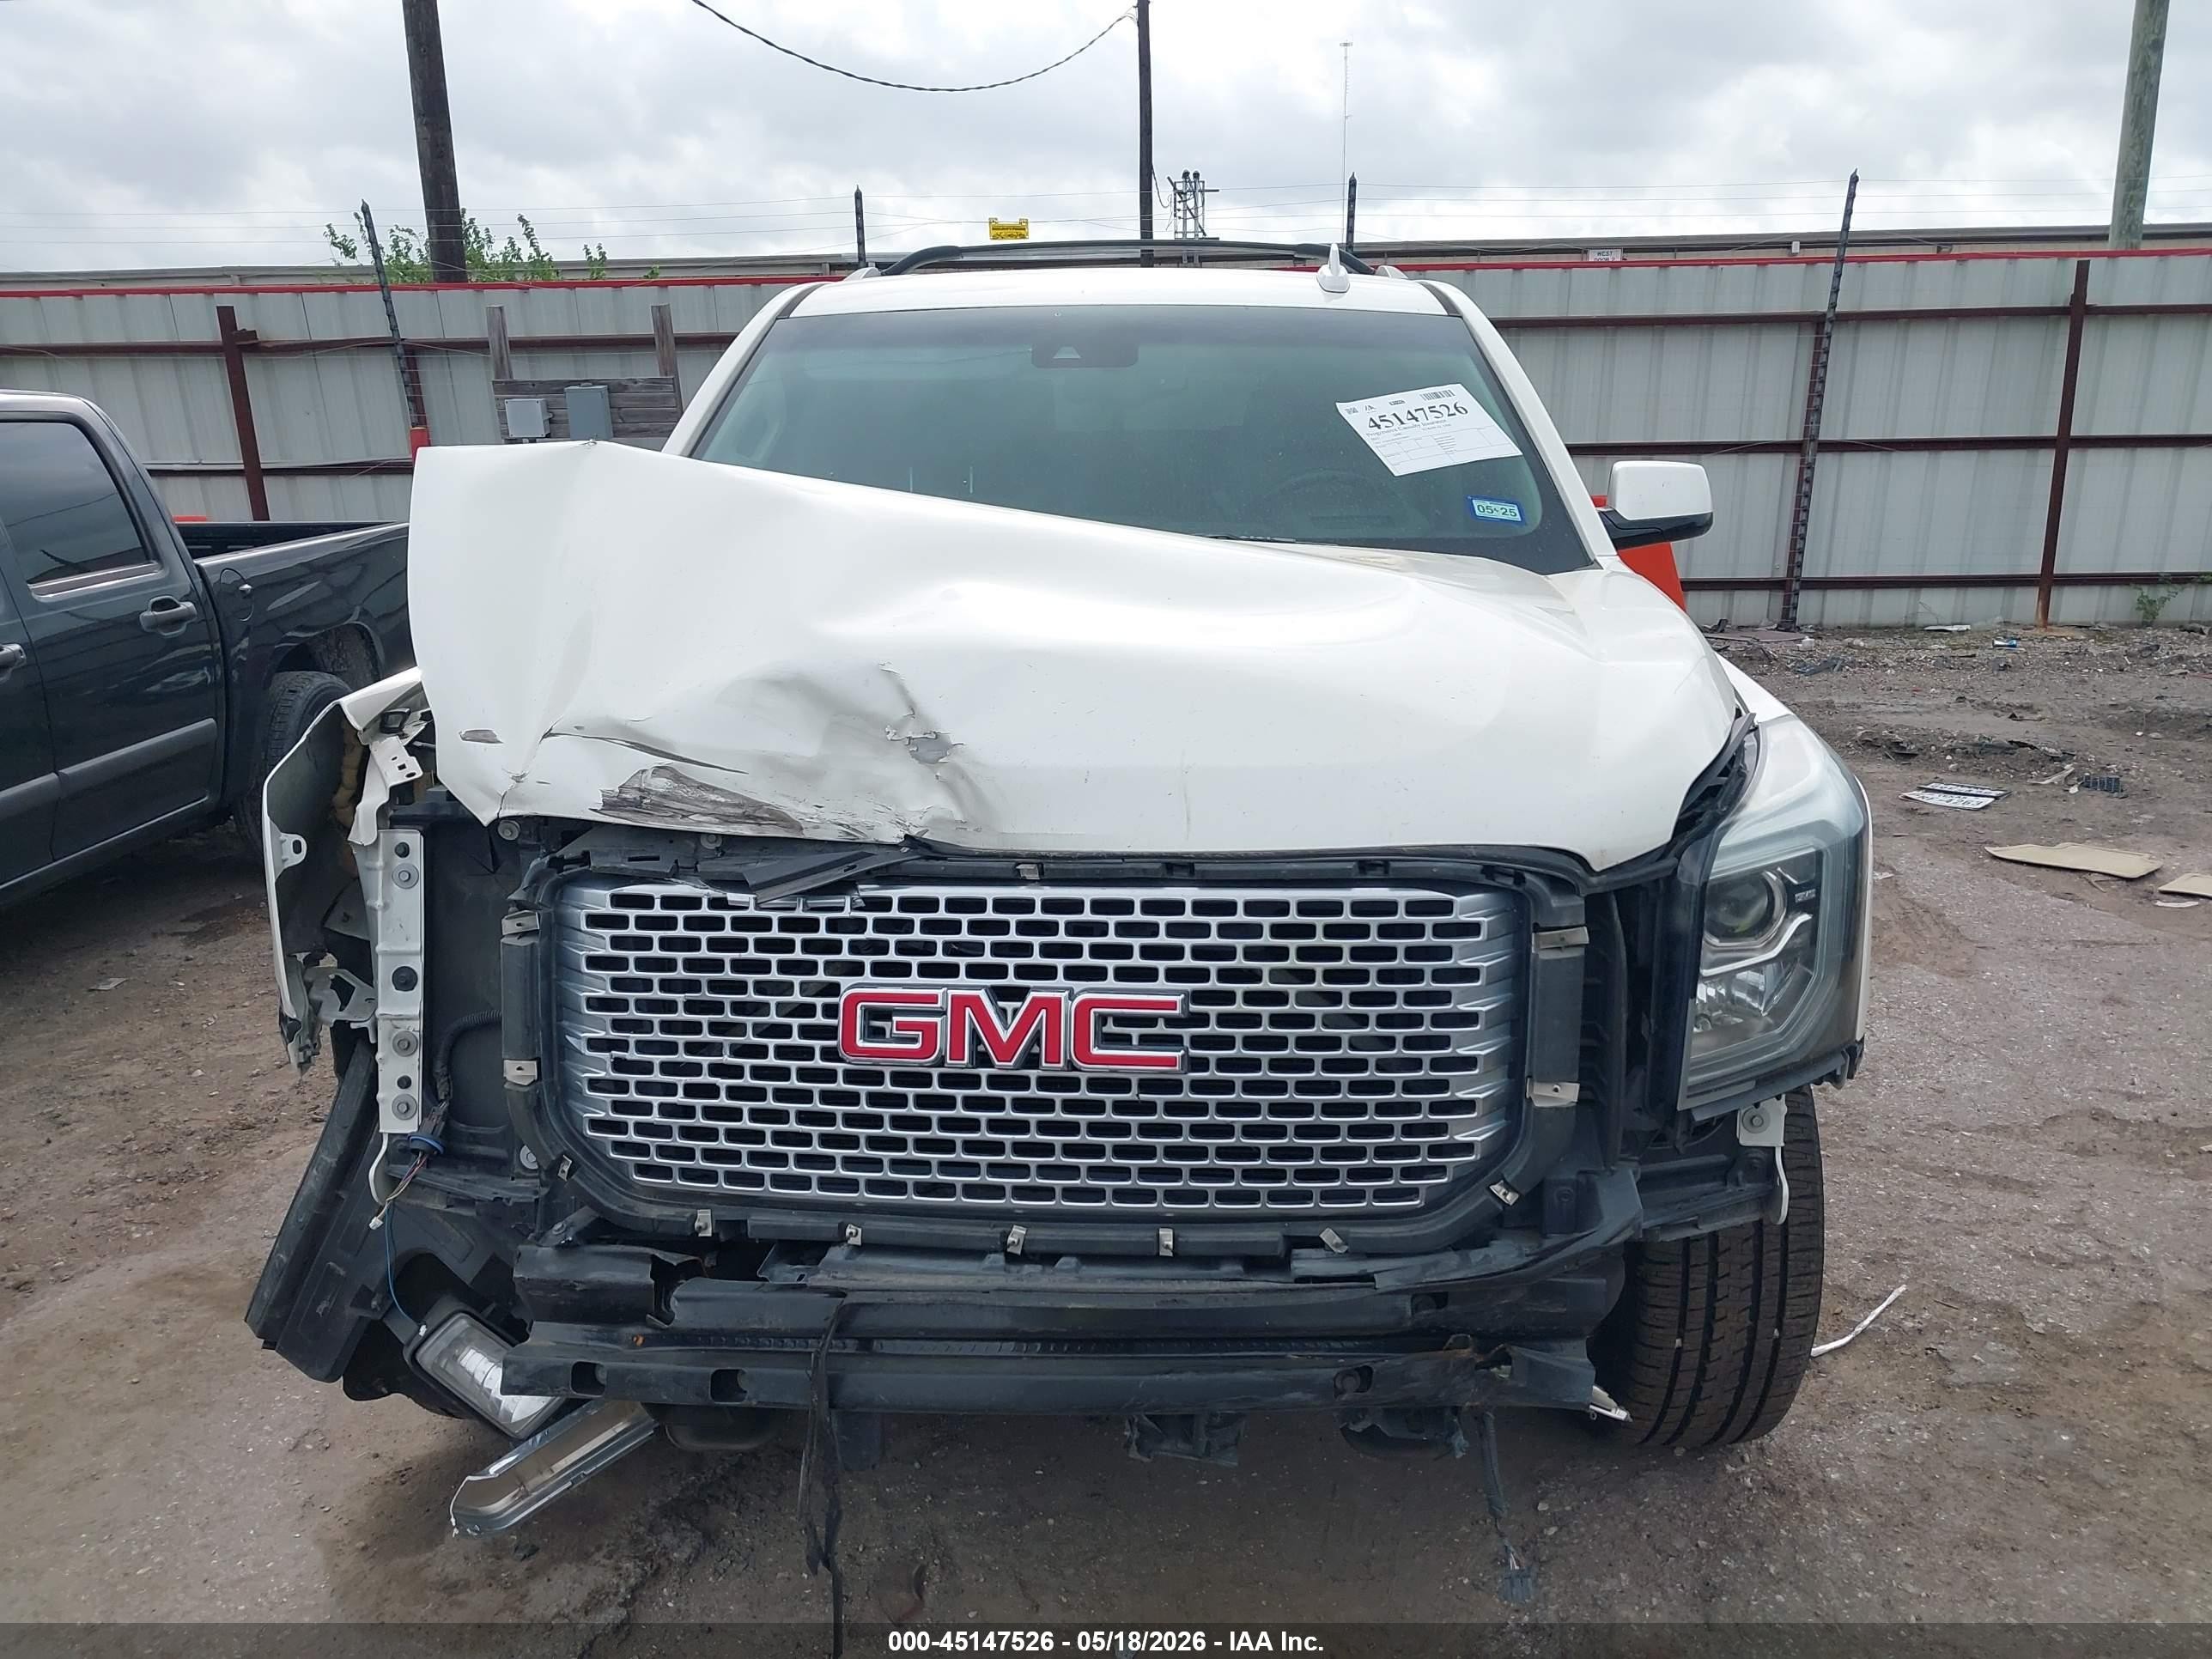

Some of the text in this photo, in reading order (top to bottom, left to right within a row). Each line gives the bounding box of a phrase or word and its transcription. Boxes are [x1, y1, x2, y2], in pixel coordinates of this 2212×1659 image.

[1368, 401, 1468, 429] 45147526
[1477, 504, 1494, 514] 05
[1499, 507, 1517, 517] 25
[838, 985, 1188, 1073] GMC
